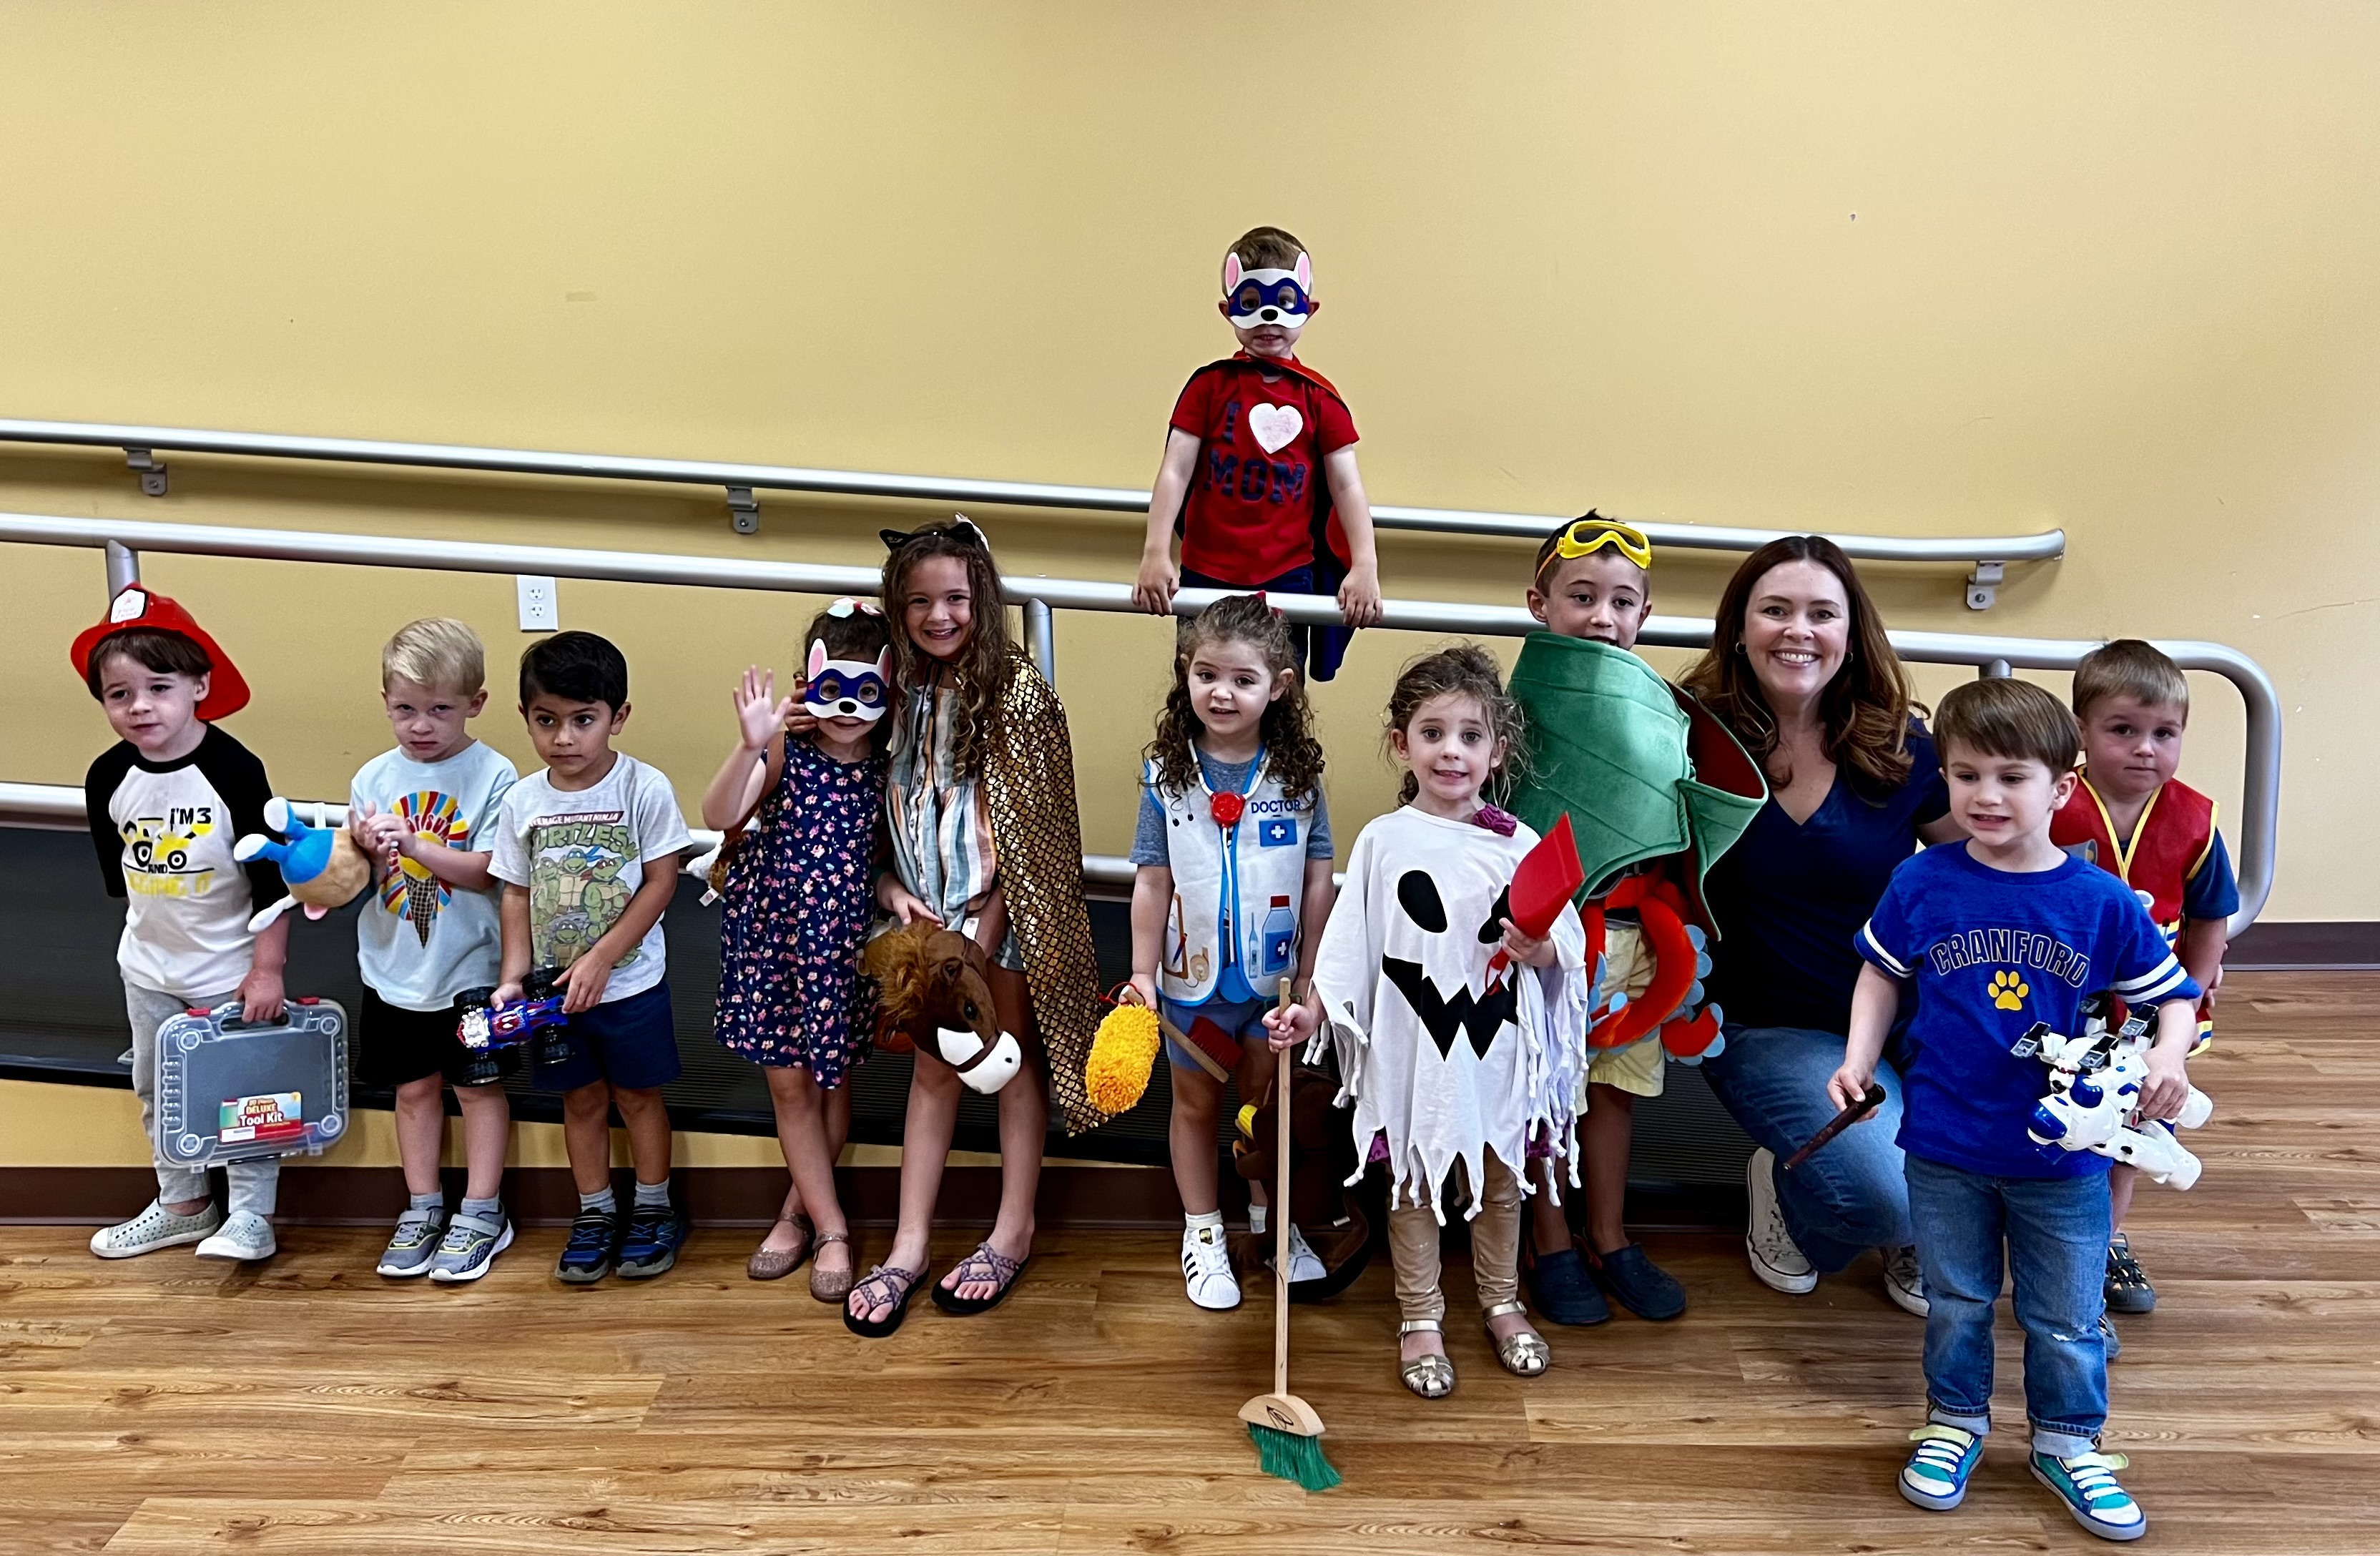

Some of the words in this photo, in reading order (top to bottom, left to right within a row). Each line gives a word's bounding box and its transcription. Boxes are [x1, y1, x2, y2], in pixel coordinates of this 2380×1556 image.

[1221, 400, 1241, 443] I
[1202, 447, 1307, 504] MOM
[1251, 799, 1300, 813] DOCTOR
[169, 807, 194, 824] I'M
[197, 807, 212, 824] 3
[593, 812, 619, 822] NINJA
[147, 863, 168, 874] AND
[1929, 928, 2091, 988] CRANFORD
[246, 1103, 275, 1114] DELUXE
[240, 1113, 264, 1126] Tool
[267, 1111, 282, 1123] Kit
